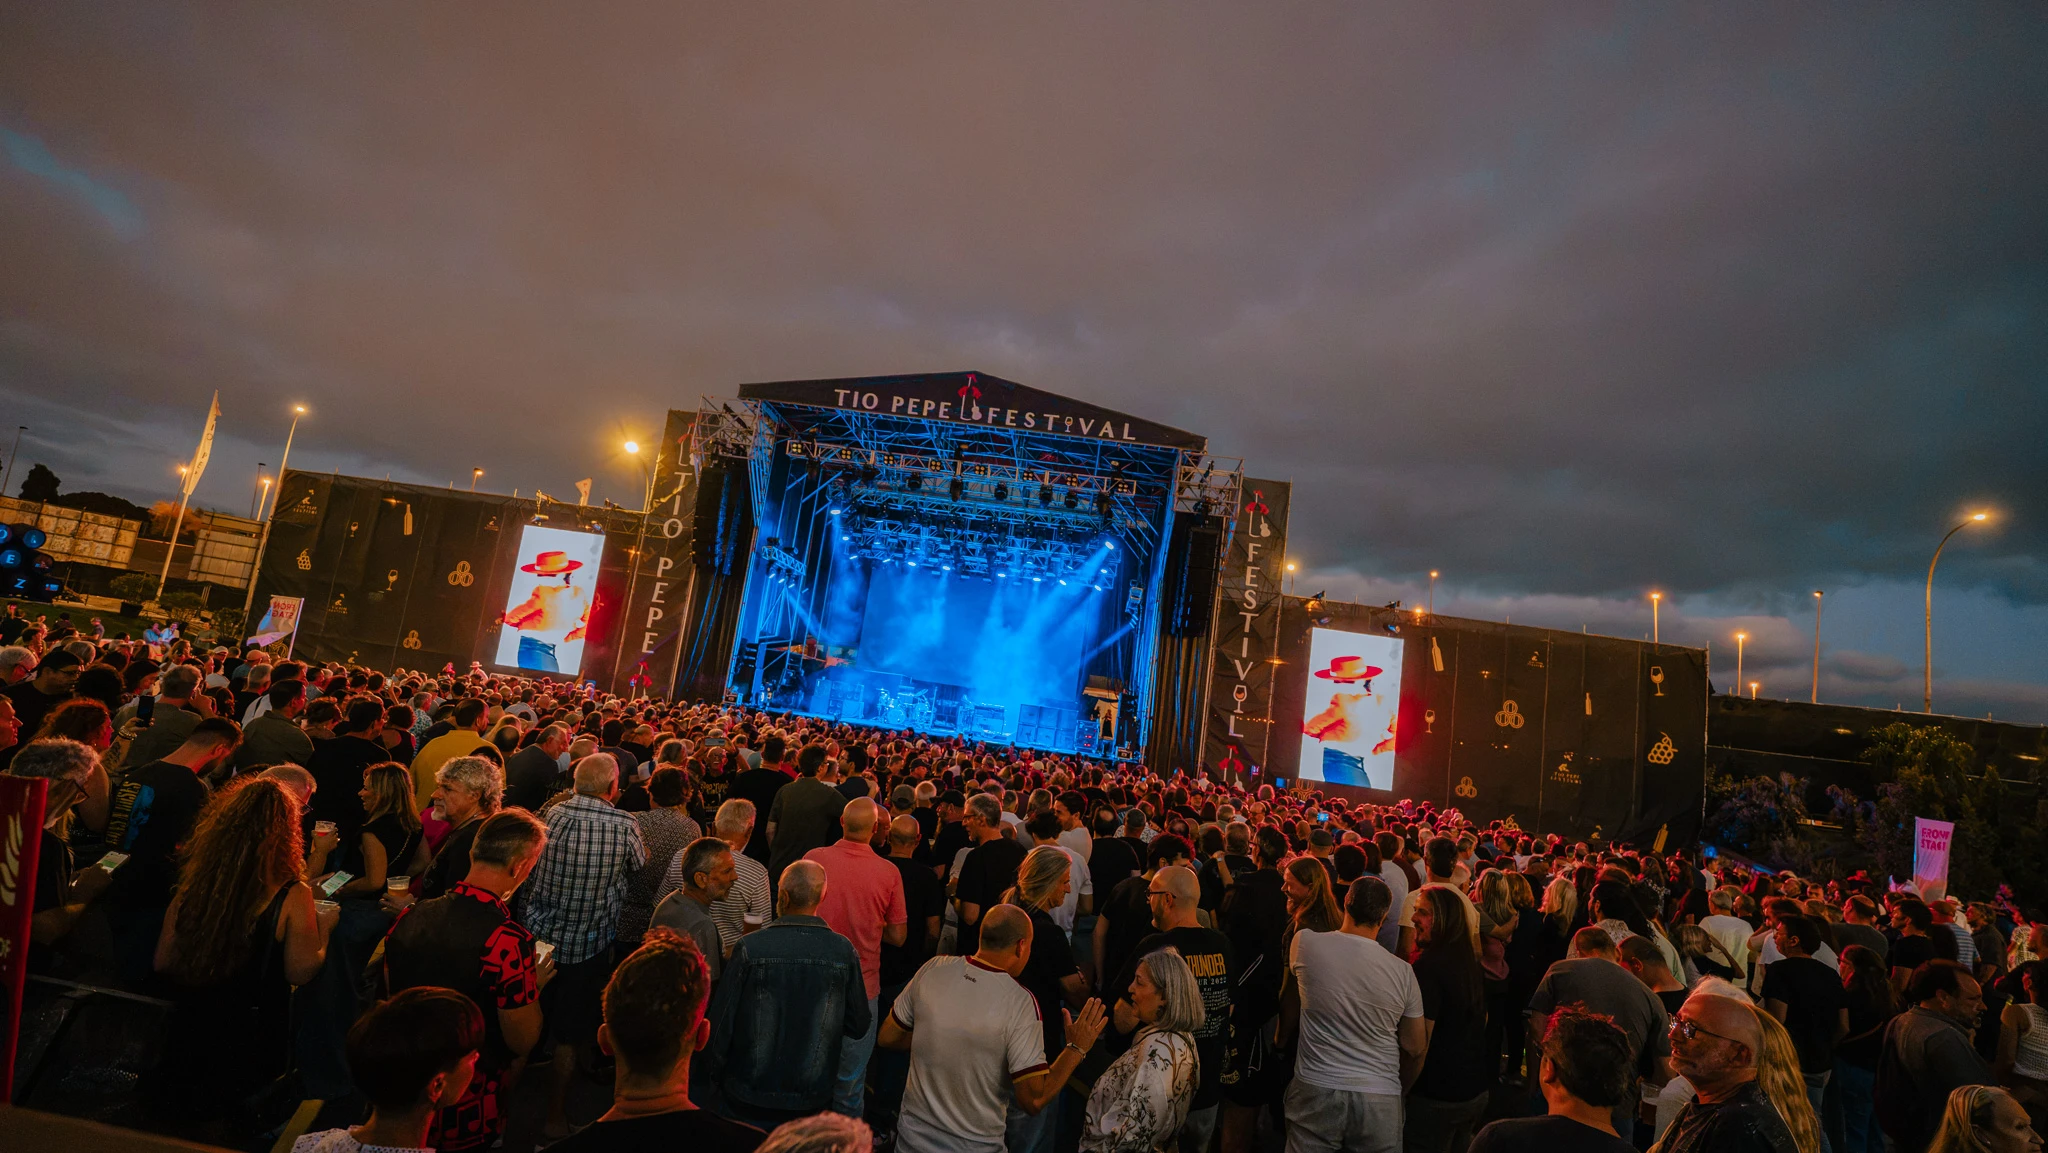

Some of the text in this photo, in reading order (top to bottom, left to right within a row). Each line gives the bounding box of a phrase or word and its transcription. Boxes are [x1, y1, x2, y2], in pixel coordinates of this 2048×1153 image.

[834, 388, 879, 410] TIO
[891, 395, 951, 419] PEPE
[642, 471, 693, 654] TIO PEPE
[1185, 953, 1226, 978] THUNDER
